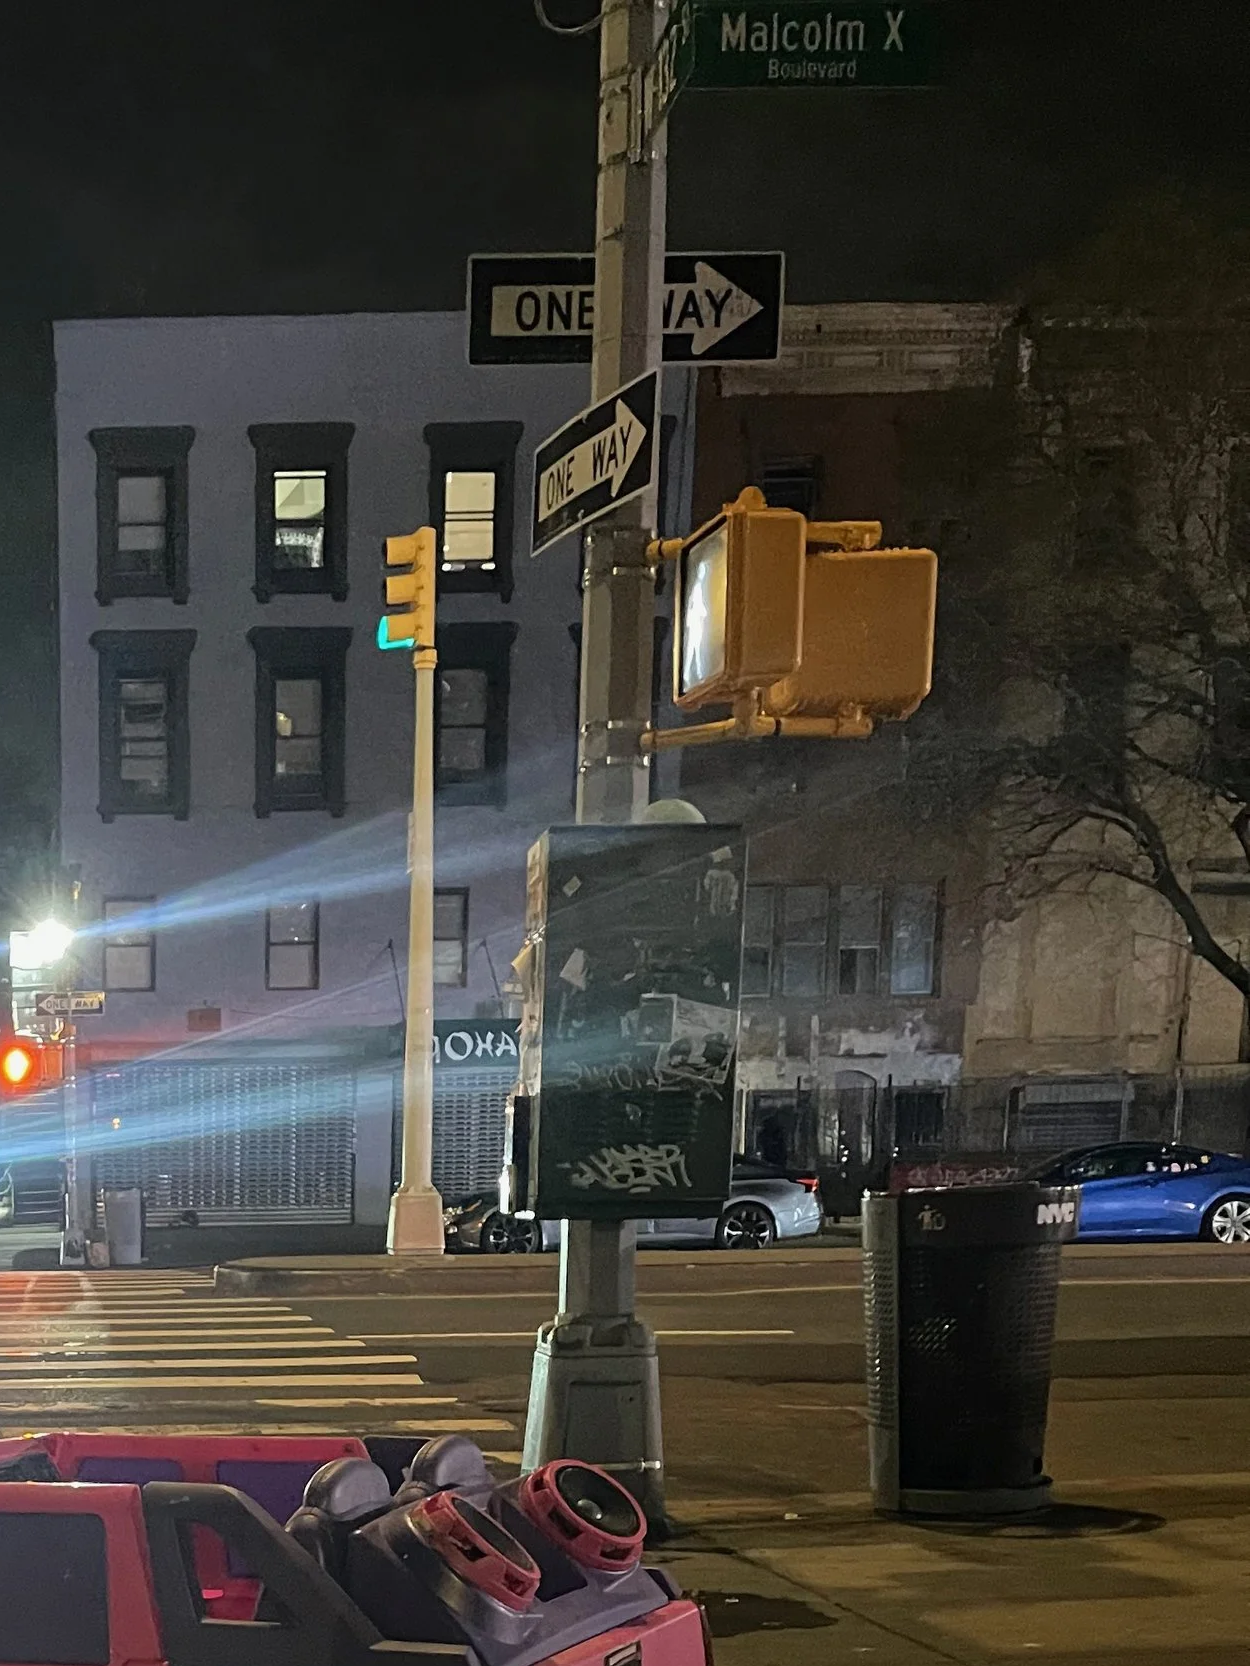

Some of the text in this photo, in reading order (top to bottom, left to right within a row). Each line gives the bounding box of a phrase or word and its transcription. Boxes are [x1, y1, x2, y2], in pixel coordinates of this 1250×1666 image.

[721, 10, 904, 52] Malcolm X
[767, 58, 857, 79] Boulevard
[515, 290, 594, 332] ONE
[545, 419, 633, 510] ONE WAY
[46, 1000, 94, 1009] ONE WAY
[1037, 1202, 1075, 1225] NYC
